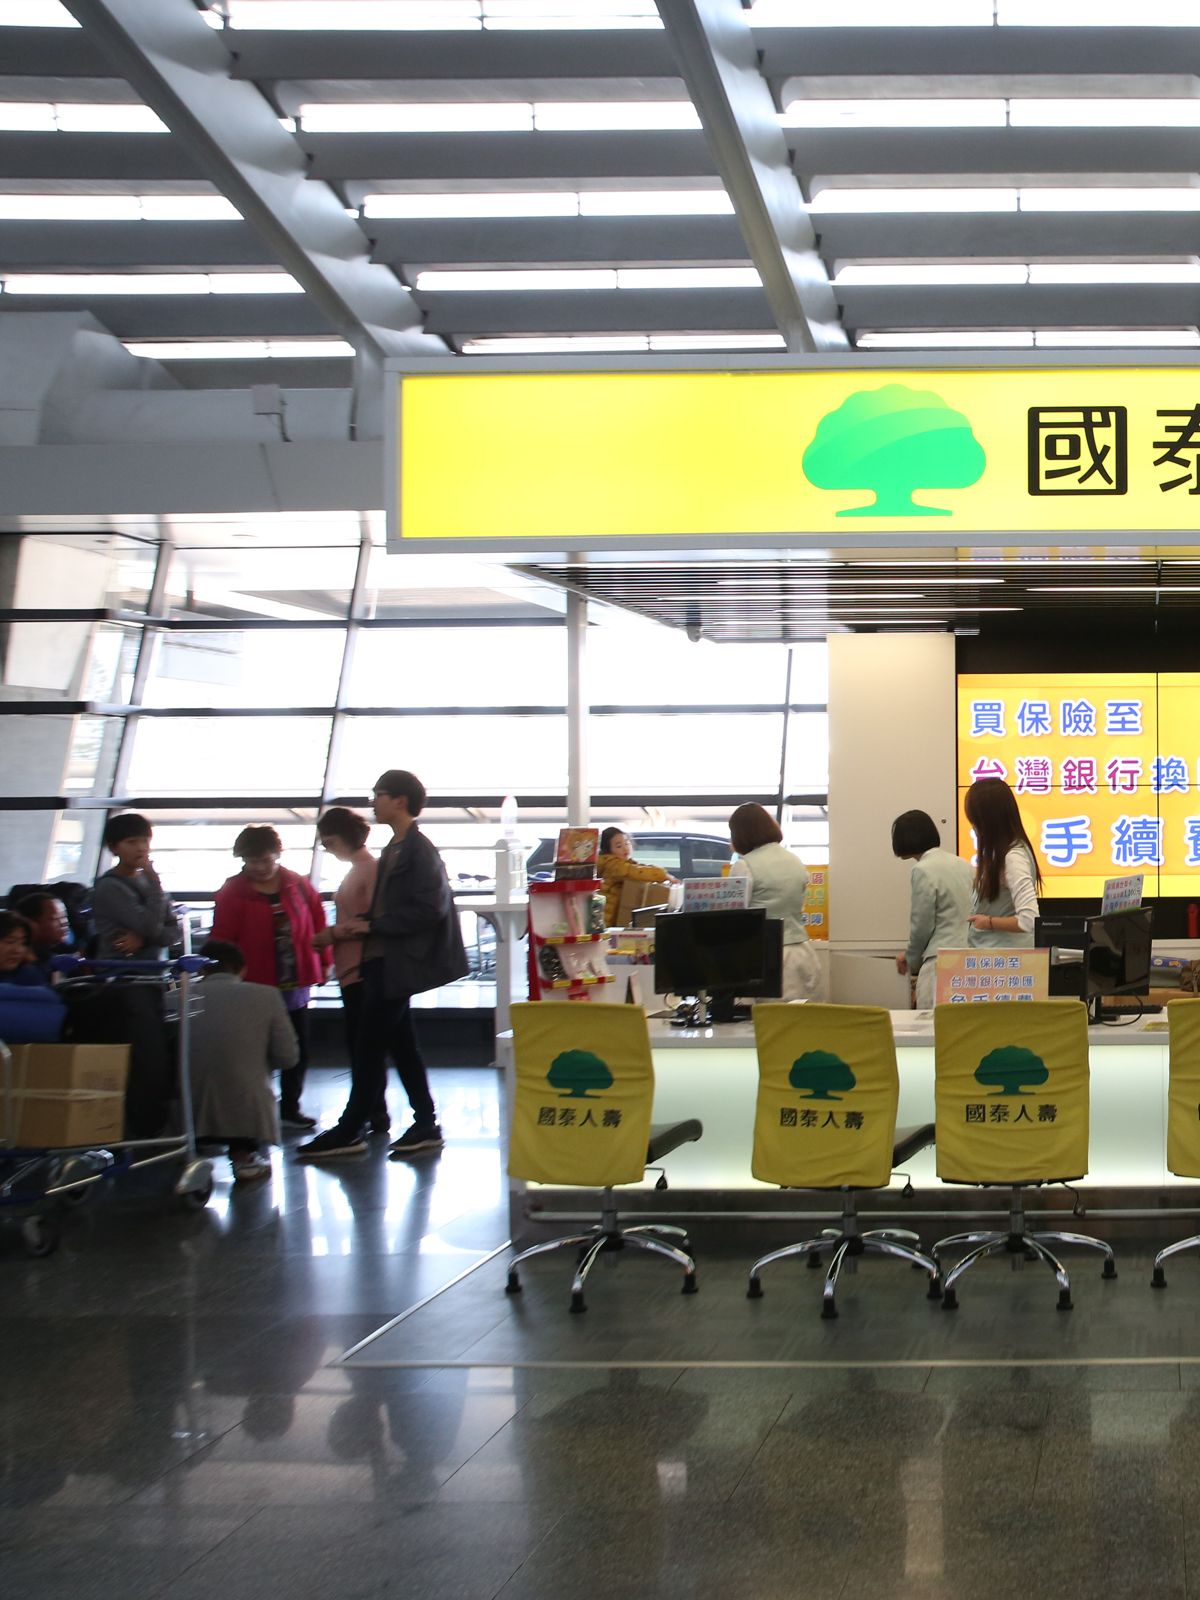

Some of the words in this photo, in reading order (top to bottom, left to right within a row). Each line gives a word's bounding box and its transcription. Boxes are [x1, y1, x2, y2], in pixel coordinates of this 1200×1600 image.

[971, 701, 1142, 735] 買保險至
[966, 957, 1019, 968] 買保險至
[538, 1107, 622, 1128] 國泰人壽
[780, 1108, 864, 1130] 國泰人壽
[966, 1104, 1057, 1123] 國泰人壽
